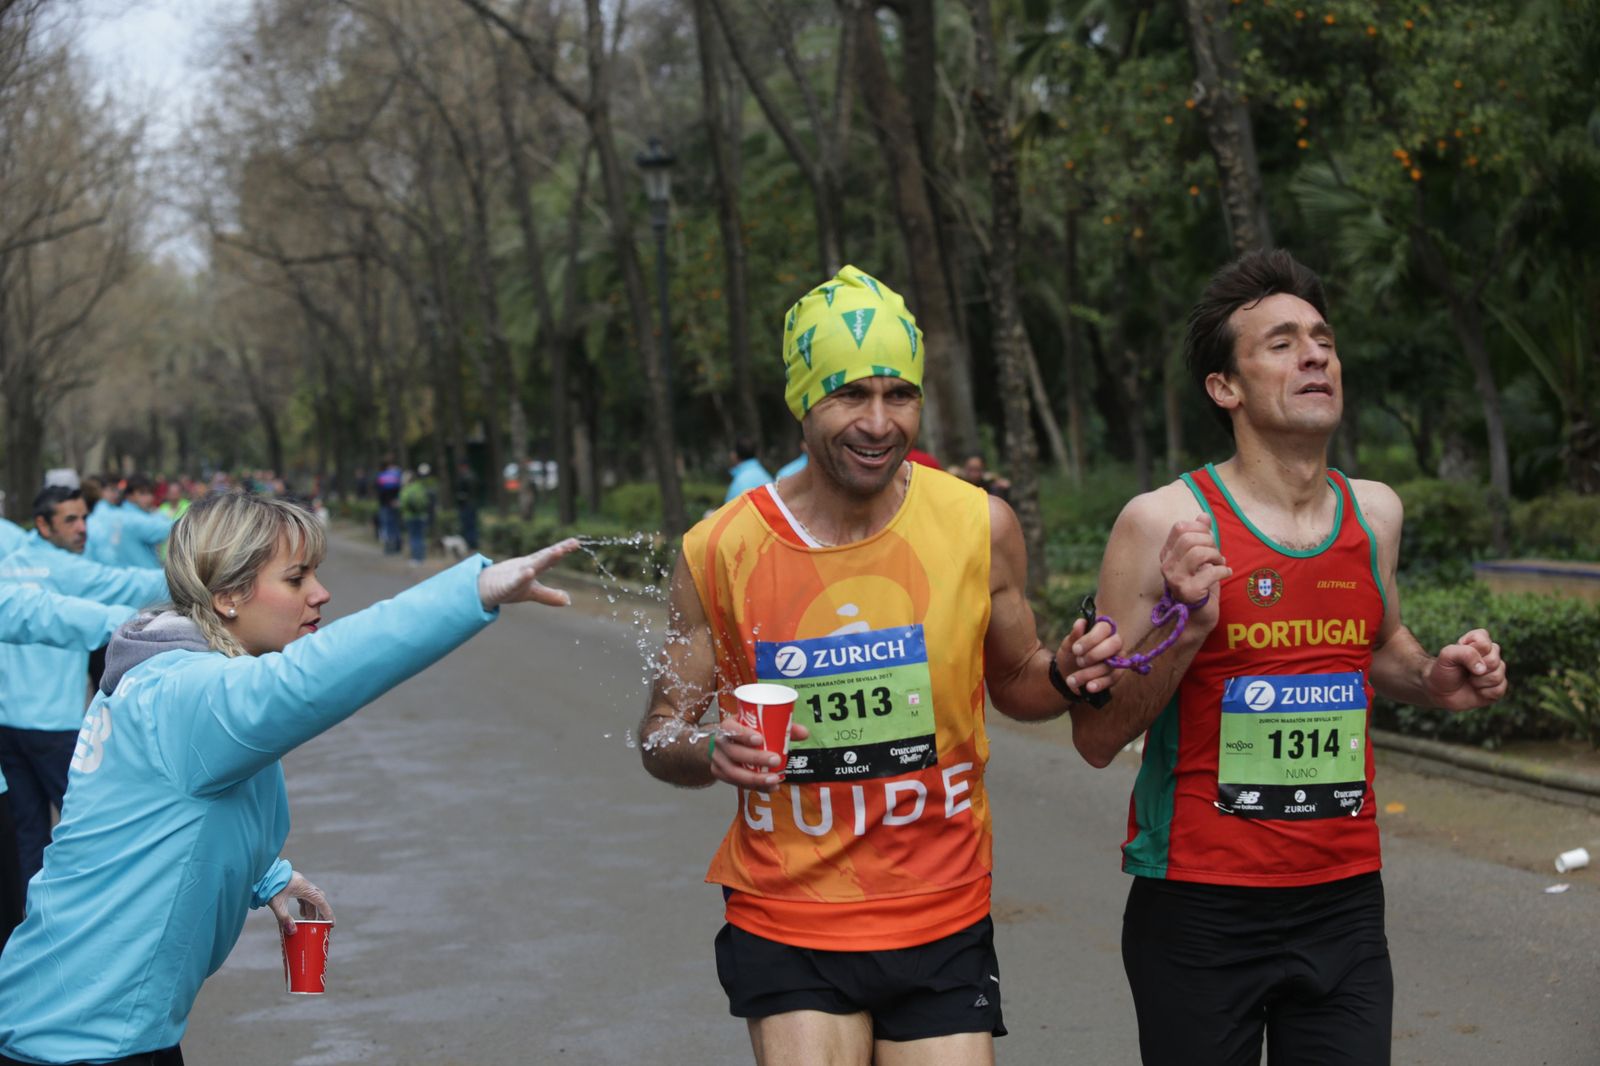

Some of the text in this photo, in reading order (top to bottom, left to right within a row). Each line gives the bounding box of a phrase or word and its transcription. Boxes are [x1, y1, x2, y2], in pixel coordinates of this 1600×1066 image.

[1227, 618, 1370, 649] PORTUGAL
[813, 639, 905, 669] ZURICH
[806, 686, 893, 724] 1313
[1281, 685, 1354, 706] ZURICH
[889, 744, 930, 756] Cruzcampo
[1268, 728, 1340, 759] 1314
[835, 764, 870, 775] ZURICH
[1286, 768, 1318, 779] NUNO
[744, 763, 973, 836] GUIDE
[1284, 804, 1316, 814] ZURICH
